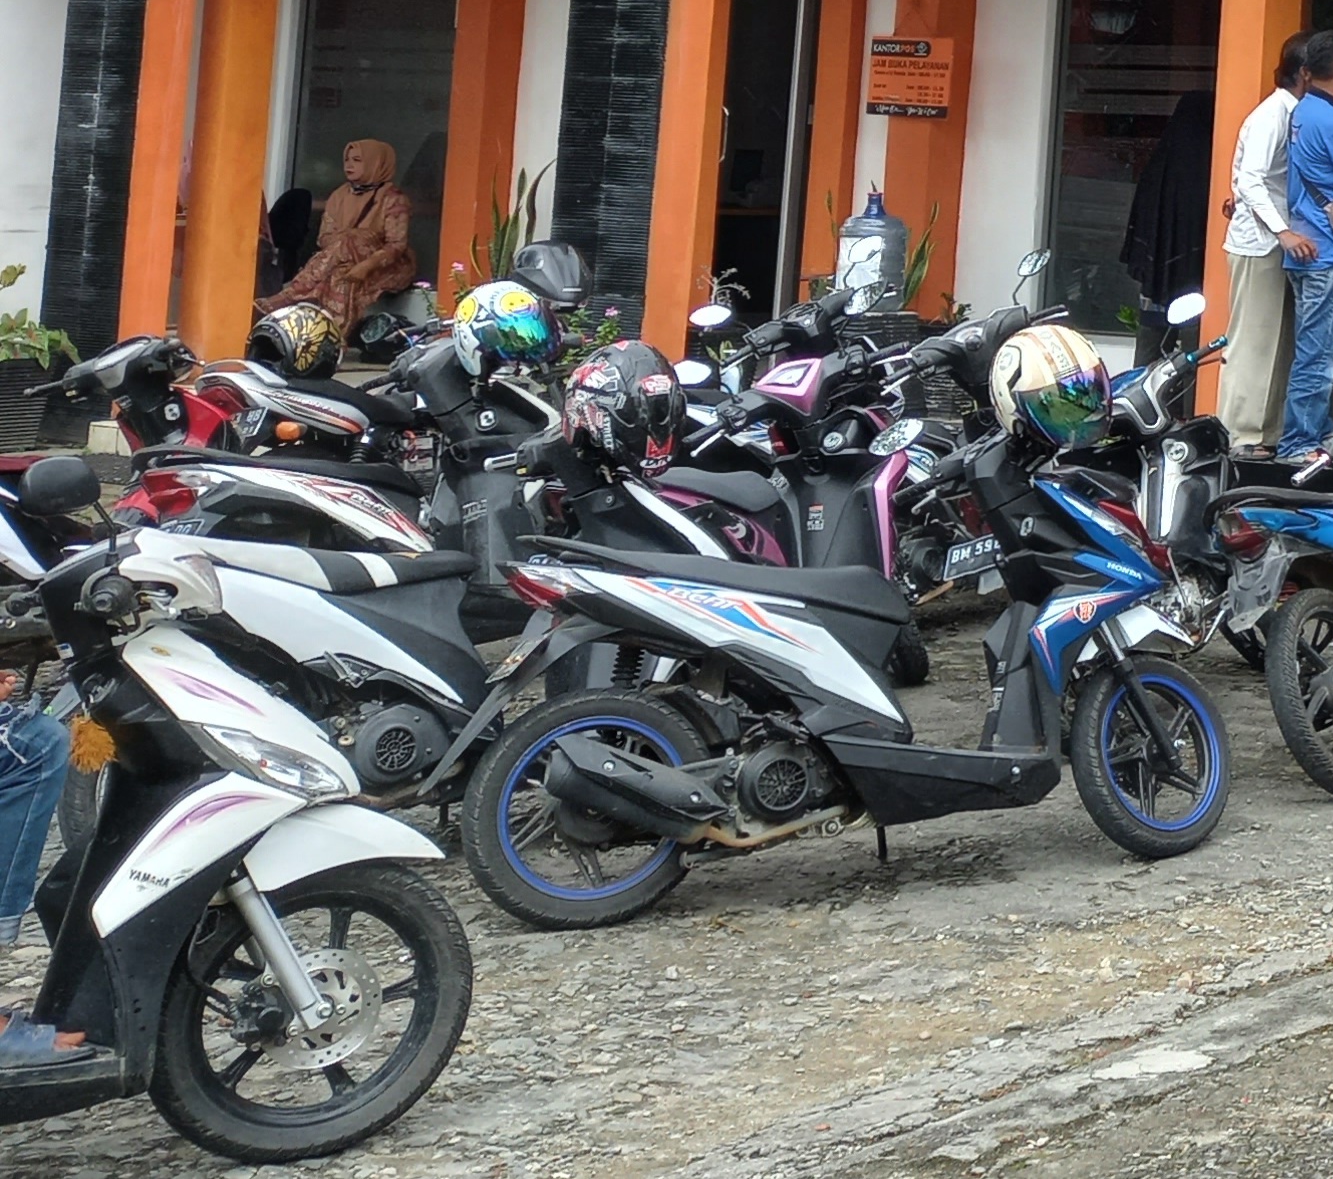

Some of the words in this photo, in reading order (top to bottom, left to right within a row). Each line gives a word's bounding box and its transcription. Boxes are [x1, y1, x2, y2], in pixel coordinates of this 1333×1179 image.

[951, 546, 972, 564] BM
[1106, 561, 1143, 580] HONDA
[129, 869, 170, 888] YAMAHA
